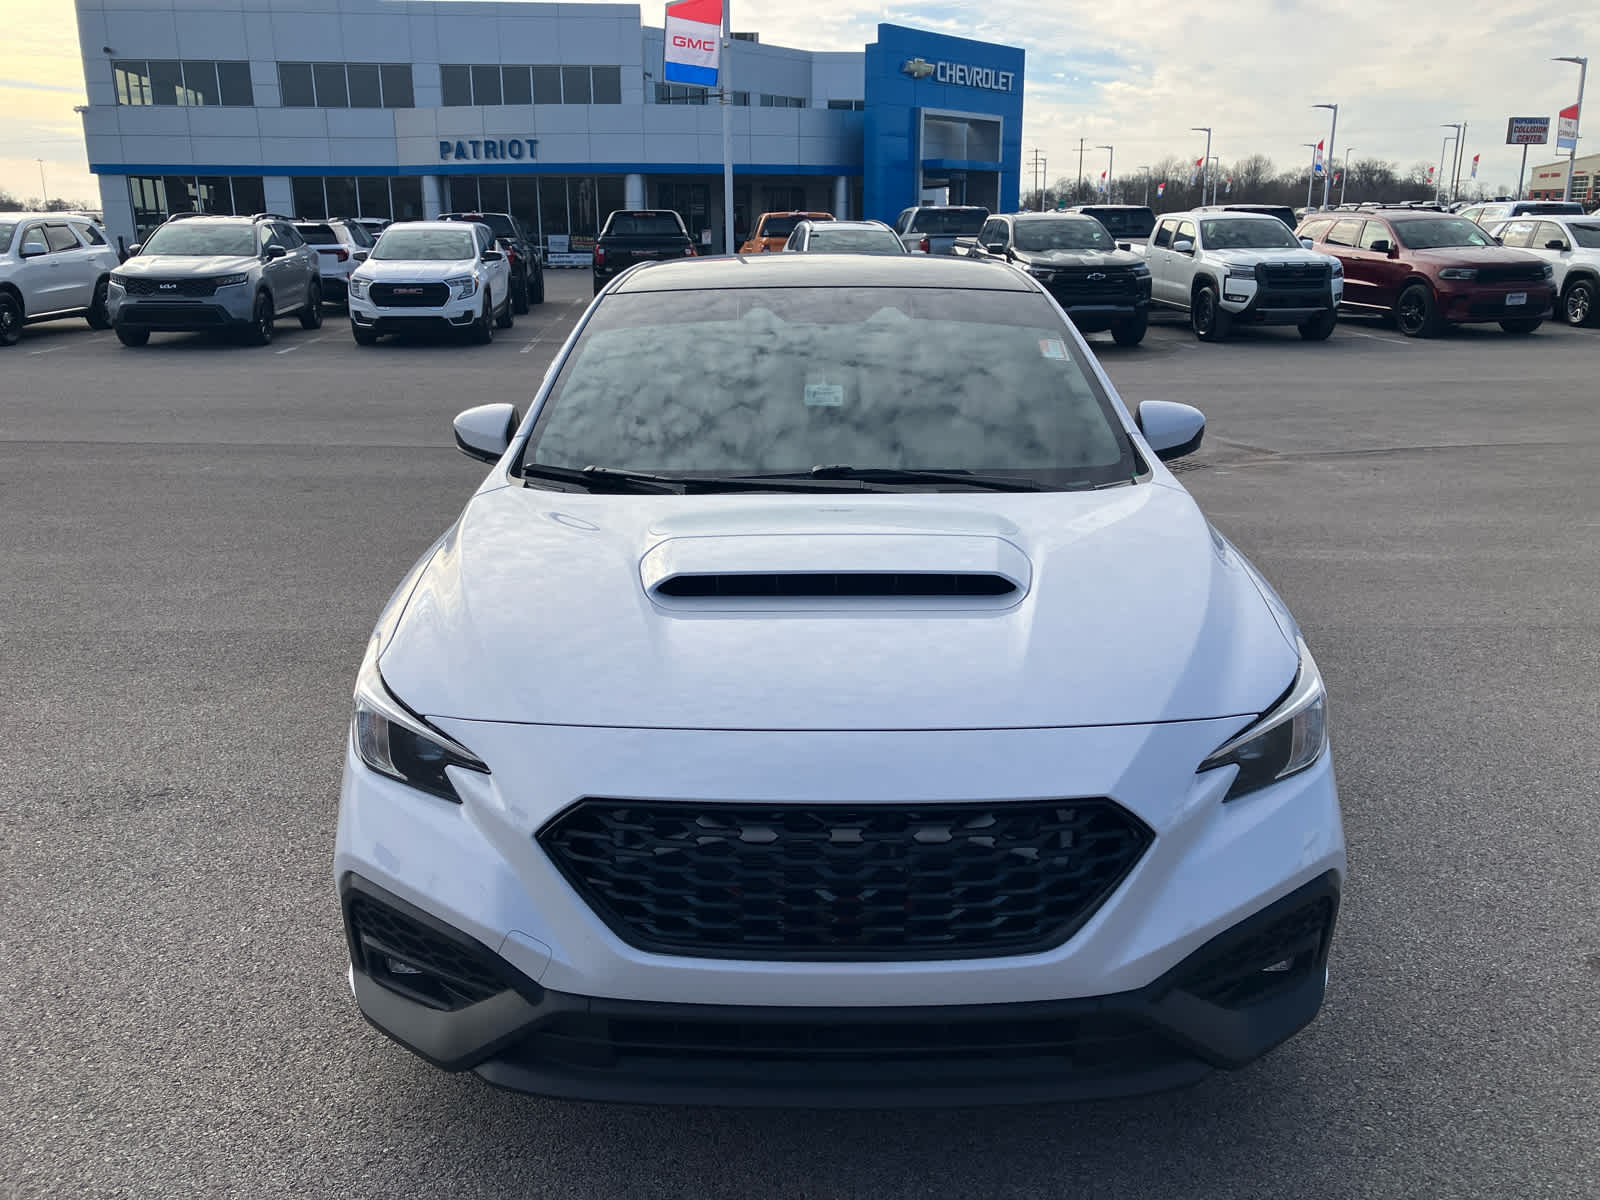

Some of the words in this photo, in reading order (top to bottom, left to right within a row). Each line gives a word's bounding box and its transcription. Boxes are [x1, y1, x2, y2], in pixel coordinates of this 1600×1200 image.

[672, 35, 715, 51] GMC
[937, 61, 1015, 91] CHEVROLET
[439, 139, 538, 160] PATRIOT
